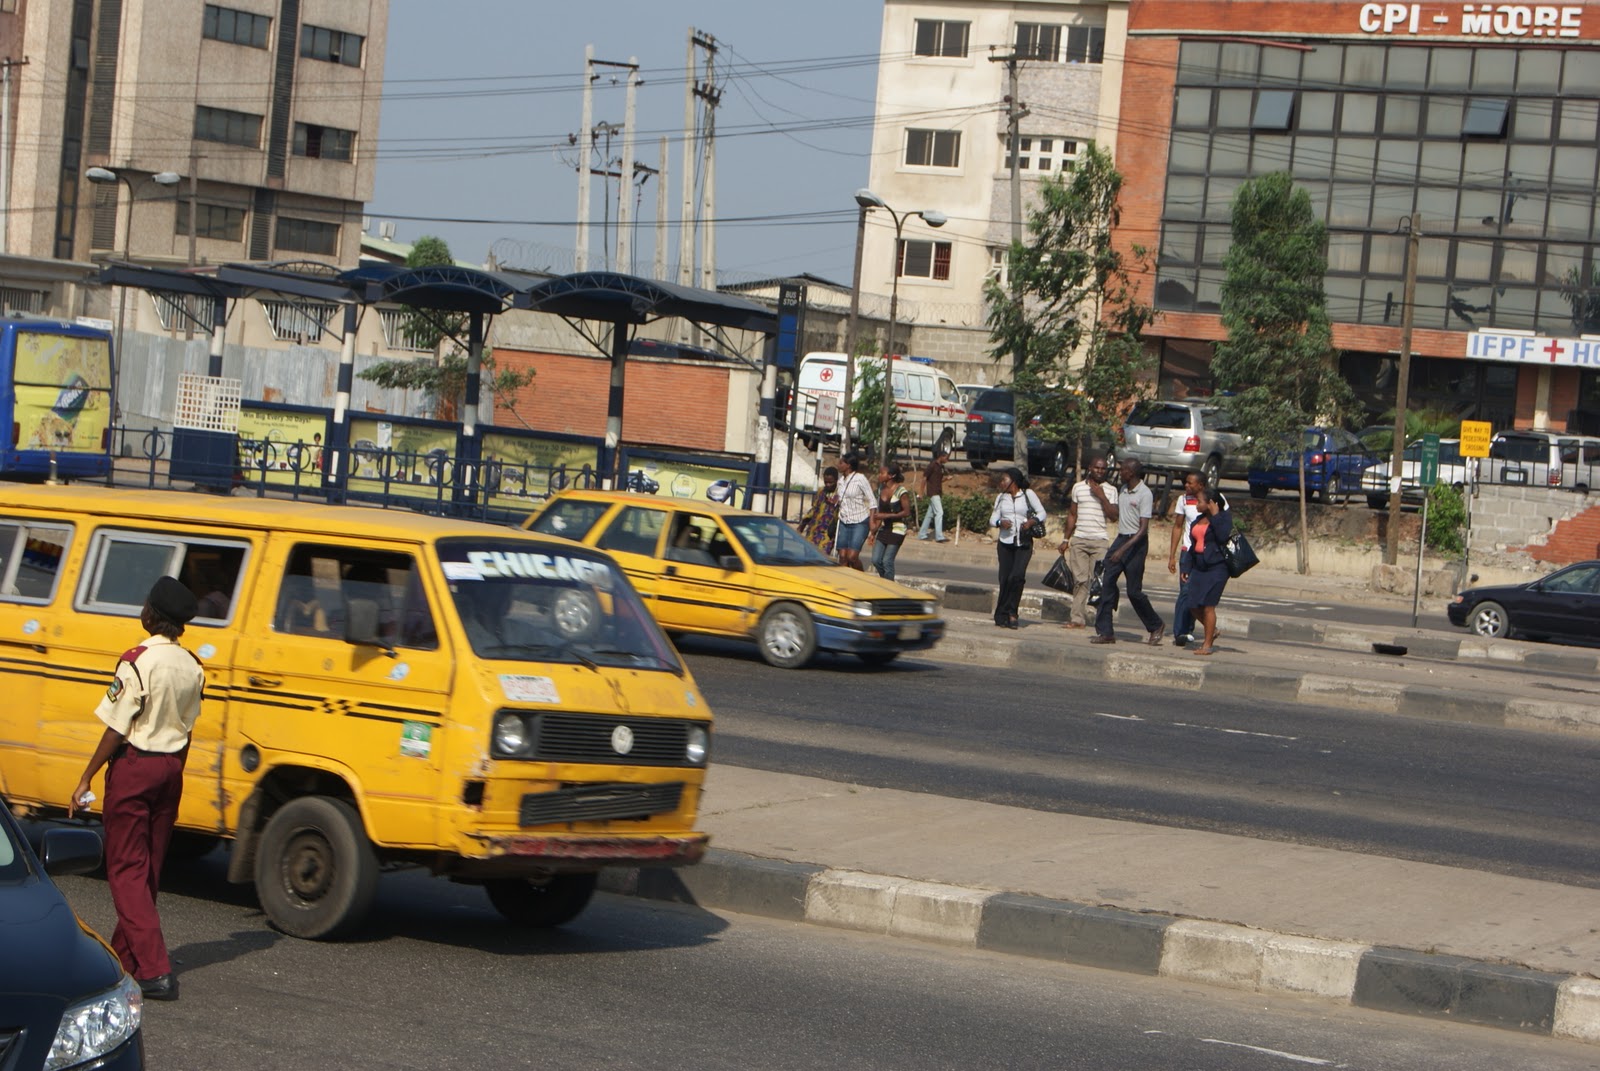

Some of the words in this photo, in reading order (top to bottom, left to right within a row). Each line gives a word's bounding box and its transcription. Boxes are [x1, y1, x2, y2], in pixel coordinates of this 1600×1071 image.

[1359, 3, 1421, 34] CPI
[1461, 4, 1583, 38] MOORE
[785, 290, 797, 299] BUS
[782, 298, 798, 306] STOP
[1472, 334, 1535, 360] IFPF
[823, 403, 831, 411] NO
[243, 411, 254, 419] Win
[256, 412, 266, 420] Big
[267, 413, 284, 423] Every
[294, 416, 312, 424] Days!
[1463, 435, 1488, 443] PEDESTRIAN
[1465, 443, 1485, 451] CROSSING
